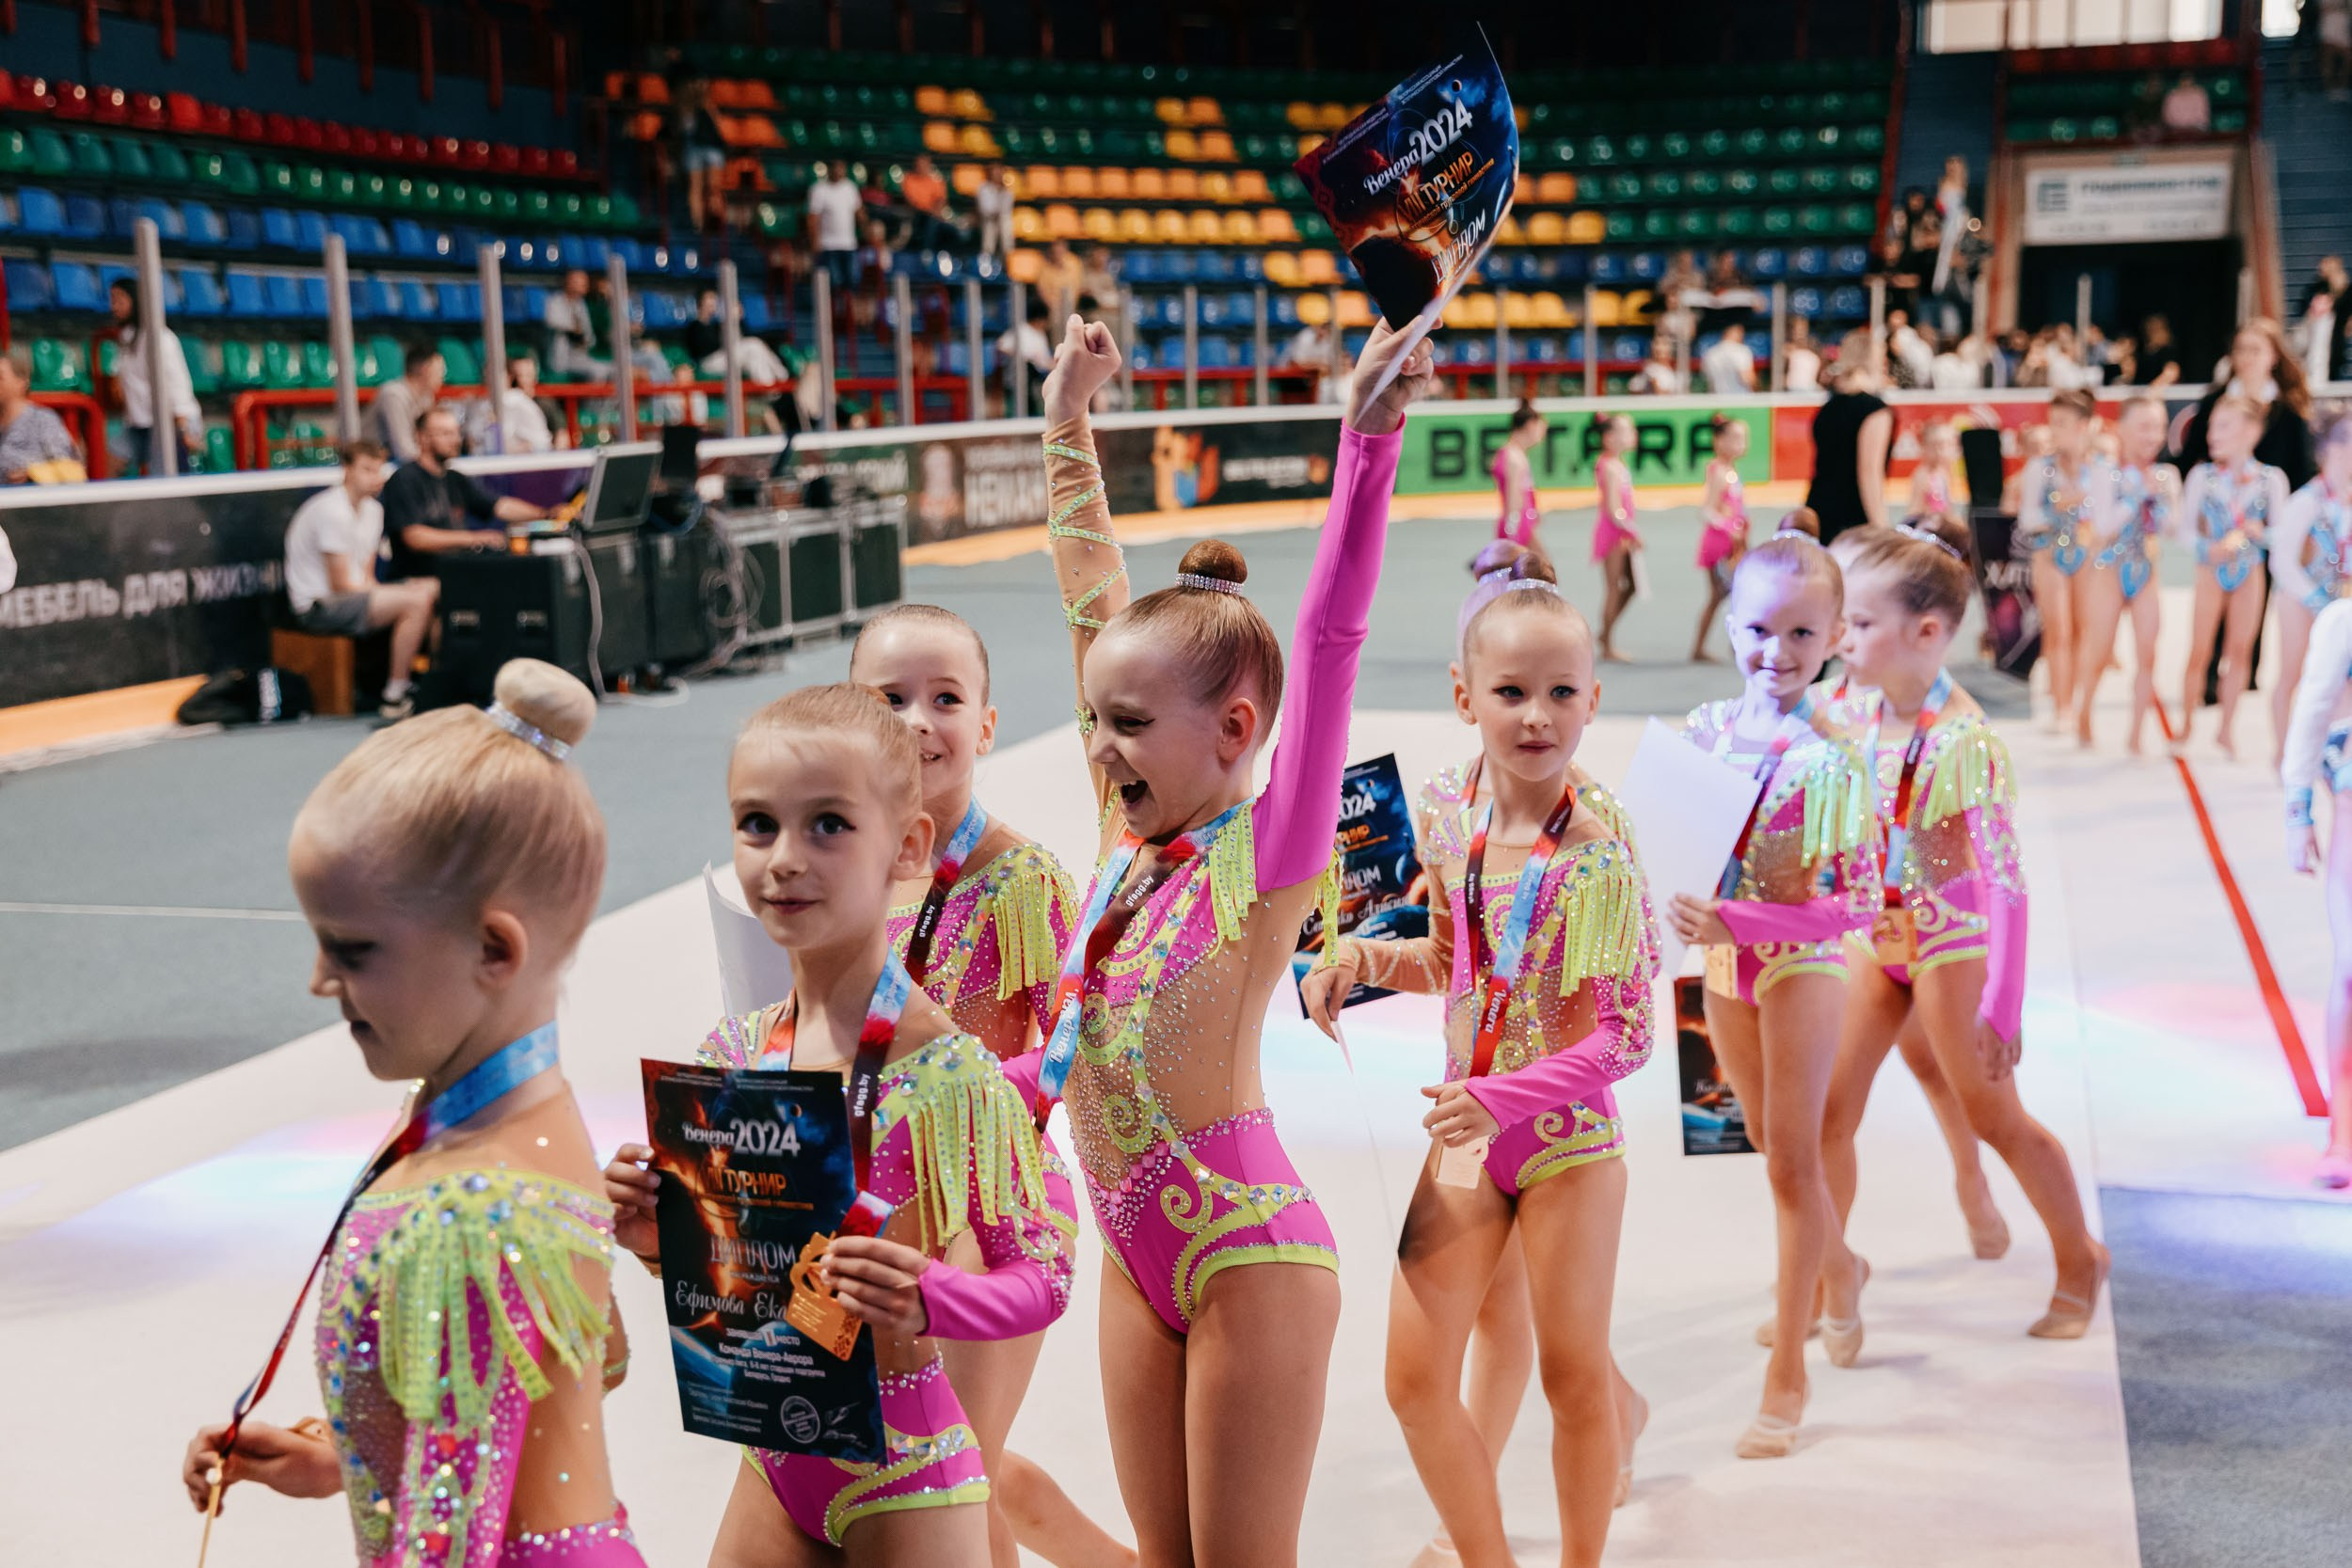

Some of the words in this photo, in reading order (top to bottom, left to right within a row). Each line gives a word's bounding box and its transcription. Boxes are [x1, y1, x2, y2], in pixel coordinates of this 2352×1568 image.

[1421, 150, 1474, 206] ТУРНИР
[1431, 208, 1486, 286] ДИПЛОМ
[123, 569, 188, 619] ДЛЯ
[1335, 824, 1371, 847] РНИР
[1125, 875, 1155, 909] gfagg.by
[918, 904, 936, 939] gfagg.by
[1485, 988, 1508, 1035] Venera
[852, 1073, 871, 1118] gfagg.by
[722, 1169, 787, 1196] ТУРНИР
[710, 1234, 796, 1270] ДИПЛОМ
[675, 1280, 745, 1316] Ефимова
[754, 1292, 787, 1321] Ека
